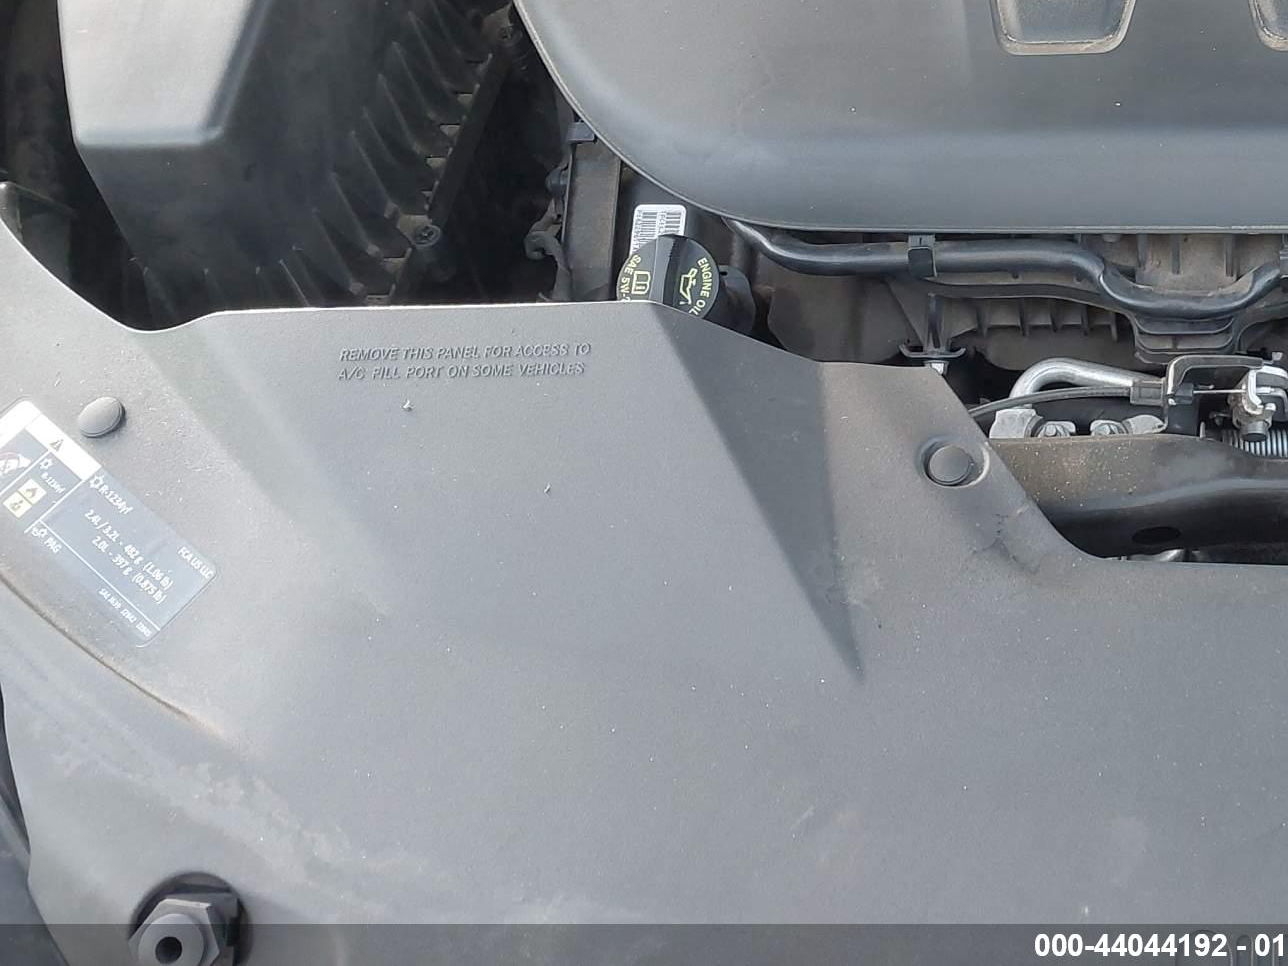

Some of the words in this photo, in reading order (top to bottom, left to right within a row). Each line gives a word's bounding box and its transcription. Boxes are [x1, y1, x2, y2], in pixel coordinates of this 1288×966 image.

[624, 254, 642, 275] SAE
[697, 257, 713, 298] ENGINE
[688, 299, 706, 316] OIL
[340, 346, 400, 362] REMOVE
[402, 345, 434, 360] THIS
[437, 345, 480, 360] PANEL
[484, 344, 512, 359] FOR
[515, 342, 569, 357] ACCESS
[574, 342, 592, 357] TO
[338, 366, 366, 381] A/C
[371, 365, 400, 380] FILL
[406, 365, 444, 379] PORT
[447, 364, 470, 379] ON
[472, 363, 514, 378] SOME
[519, 361, 586, 377] VEHICLES
[43, 535, 62, 554] PAG
[111, 553, 130, 569] 397
[177, 545, 195, 563] FCA
[199, 565, 214, 580] LLC
